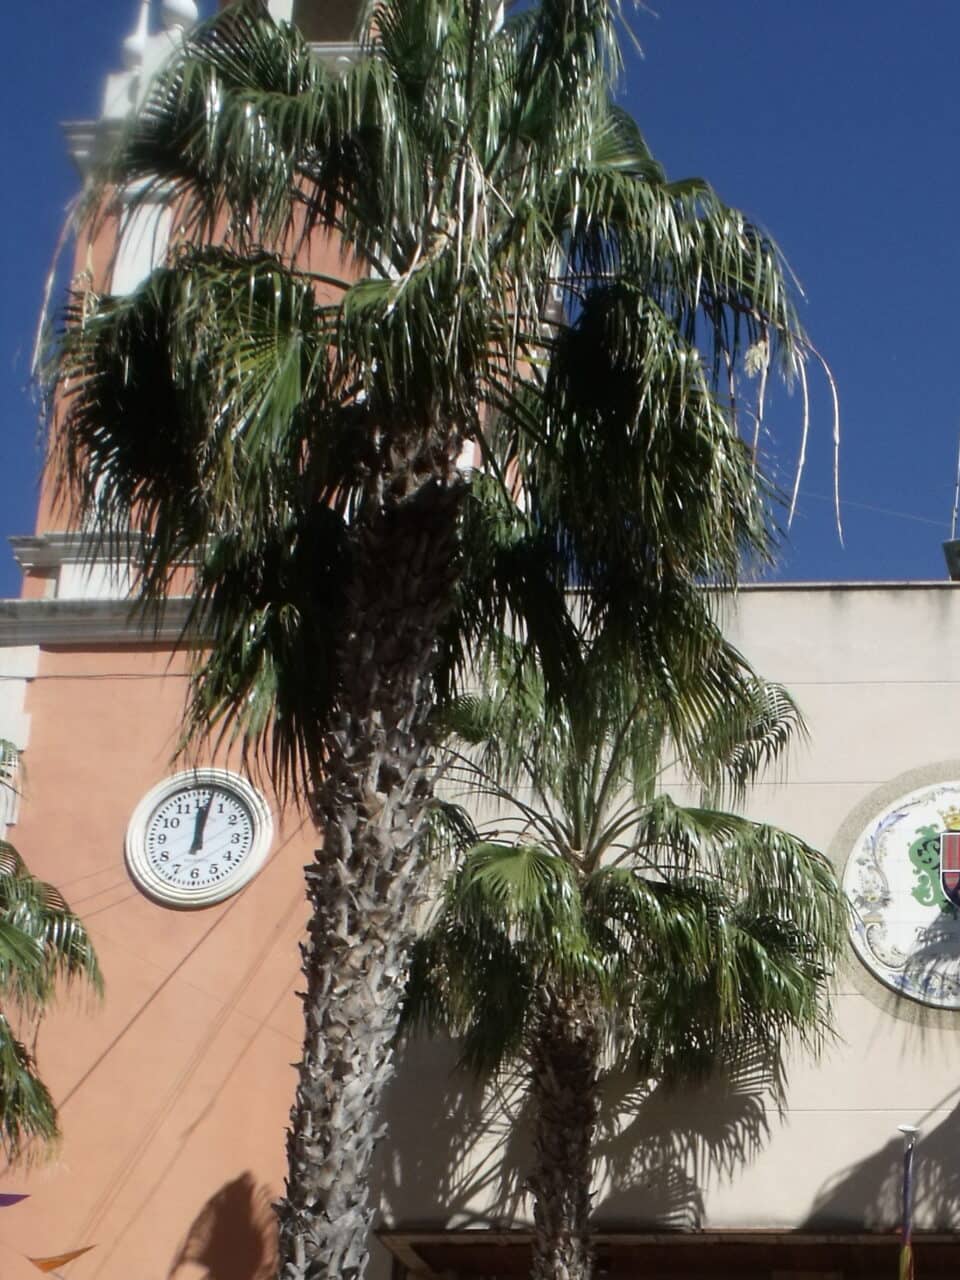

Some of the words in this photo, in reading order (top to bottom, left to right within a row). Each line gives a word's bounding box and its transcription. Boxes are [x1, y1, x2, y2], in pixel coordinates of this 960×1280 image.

[176, 804, 191, 814] 11
[217, 803, 225, 814] 1
[162, 818, 180, 828] 10
[228, 815, 238, 825] 2
[158, 834, 167, 845] 9
[231, 833, 240, 844] 3
[159, 851, 169, 862] 8
[223, 851, 232, 861] 4
[172, 864, 181, 875] 7
[190, 868, 200, 879] 6
[209, 864, 218, 875] 5
